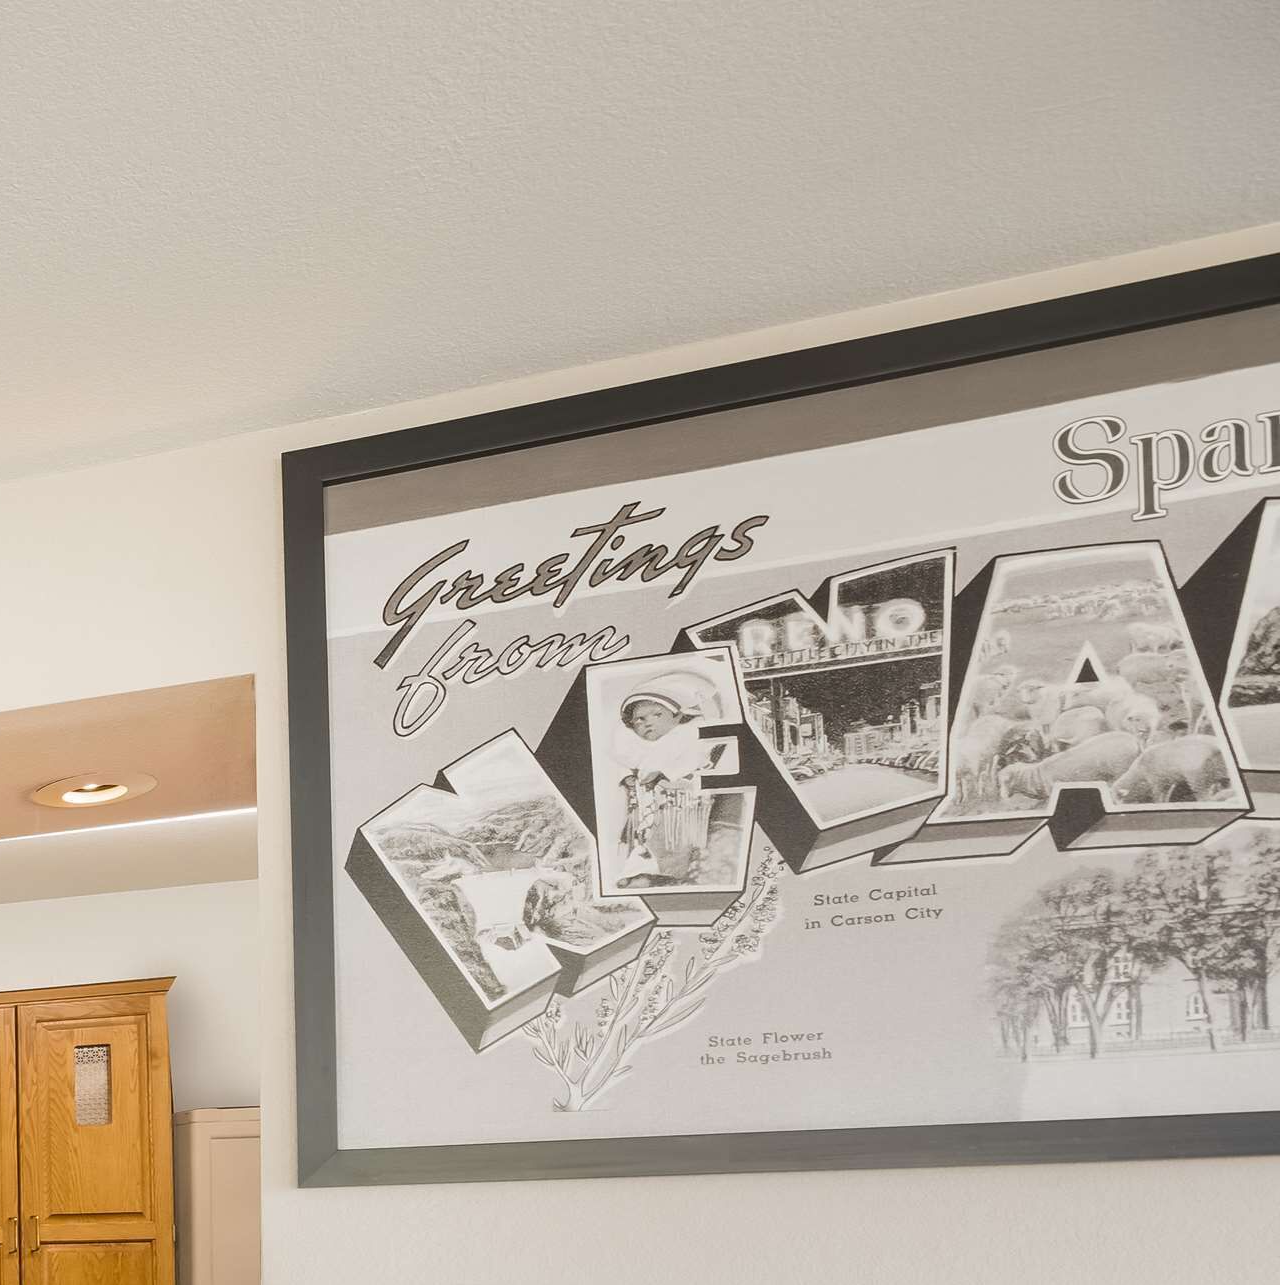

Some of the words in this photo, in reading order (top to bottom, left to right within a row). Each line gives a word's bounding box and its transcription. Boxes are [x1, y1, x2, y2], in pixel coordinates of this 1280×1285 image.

[373, 501, 770, 670] Greetings
[738, 598, 928, 657] RENO
[393, 619, 630, 738] from
[813, 893, 859, 906] State
[868, 884, 937, 901] Capital
[804, 918, 821, 930] in
[830, 913, 895, 927] Carson
[904, 907, 943, 920] City
[708, 1035, 753, 1048] State
[762, 1031, 824, 1044] Flower
[700, 1053, 726, 1065] the
[736, 1047, 832, 1065] Sagebrush
